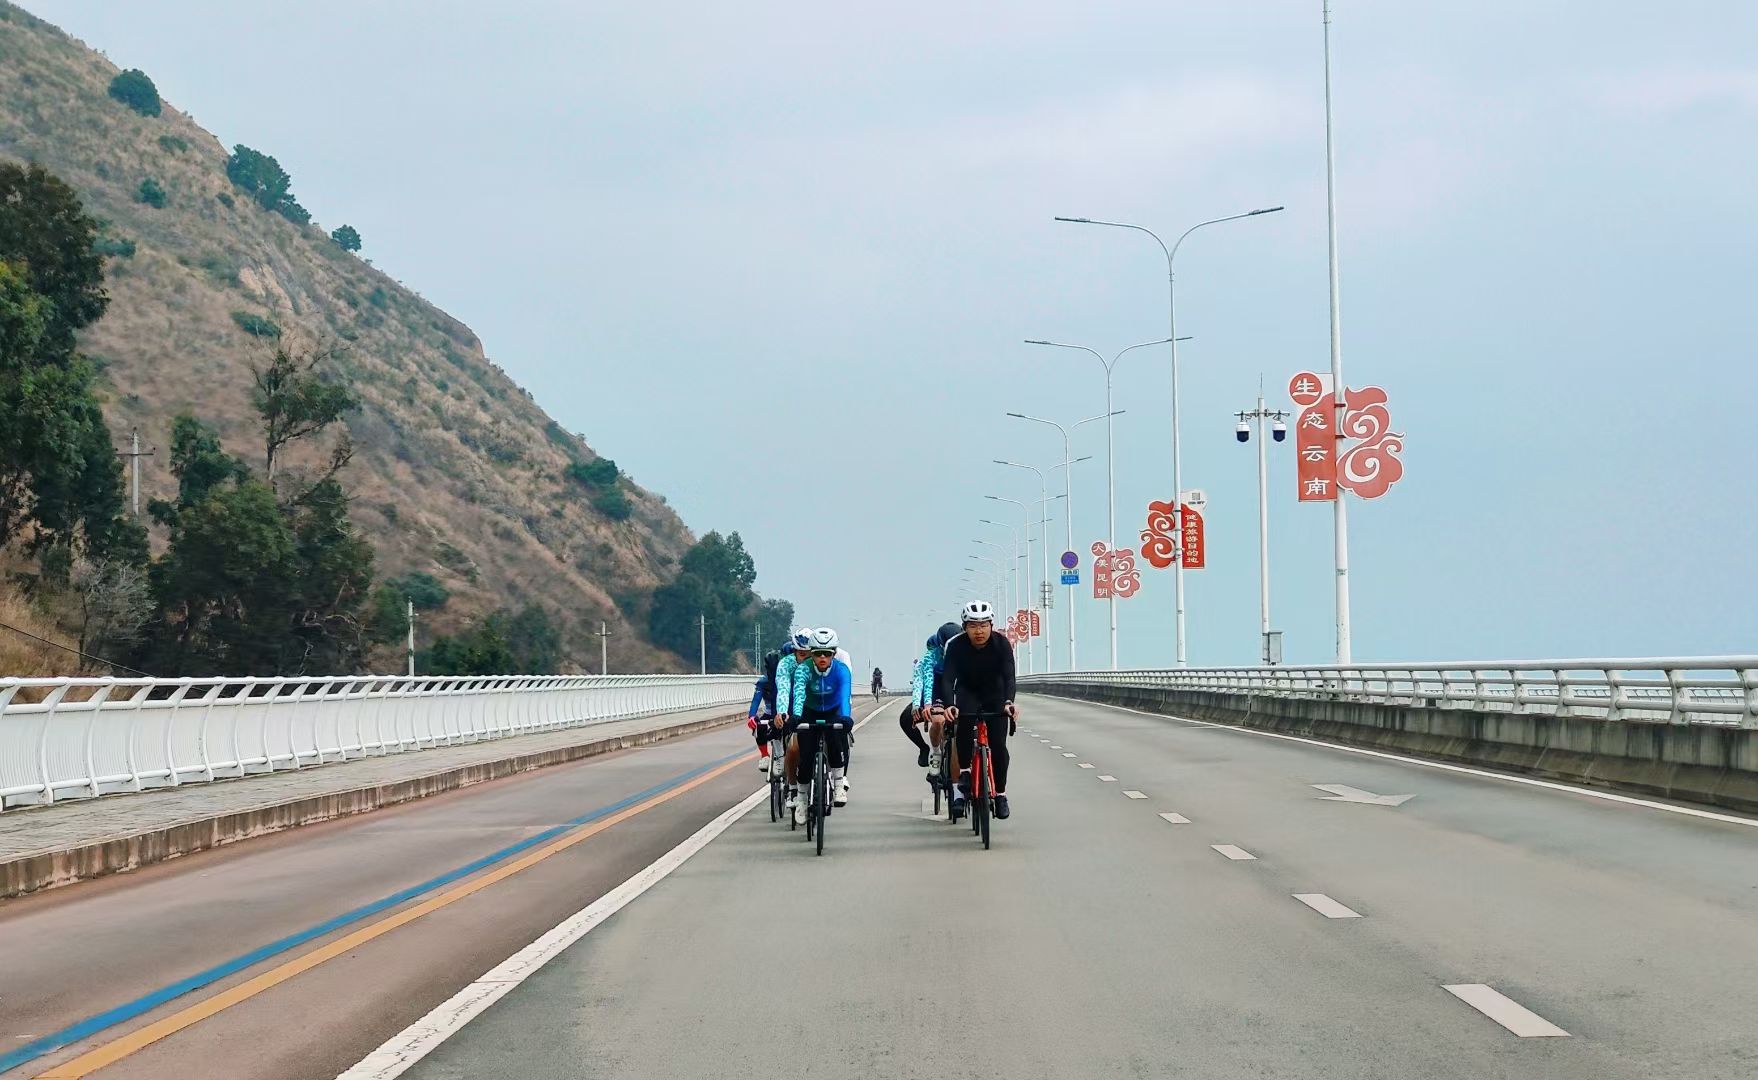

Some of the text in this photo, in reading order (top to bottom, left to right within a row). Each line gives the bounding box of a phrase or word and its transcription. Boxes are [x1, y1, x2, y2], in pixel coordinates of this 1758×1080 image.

[1291, 377, 1331, 496] 生态云南
[1093, 543, 1109, 597] 大美昆明
